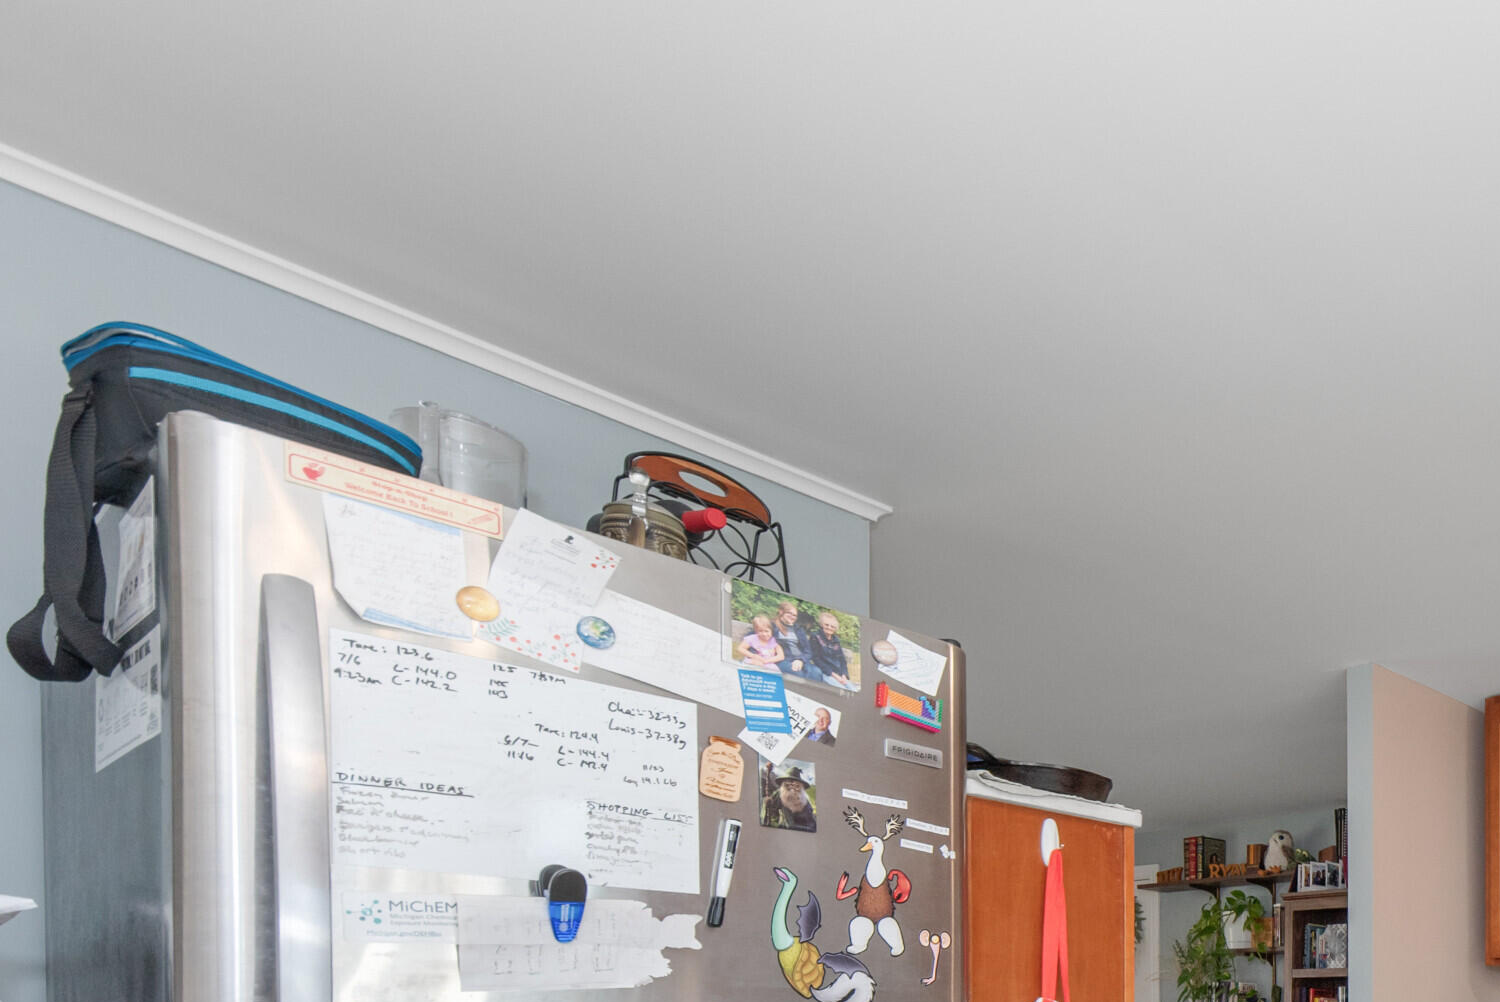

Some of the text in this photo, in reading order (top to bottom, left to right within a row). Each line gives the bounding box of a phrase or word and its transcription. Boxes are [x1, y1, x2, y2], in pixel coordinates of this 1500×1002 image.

[891, 745, 939, 763] FRIGIDAIRE
[335, 771, 465, 796] DINNER IDEAS
[586, 799, 654, 817] SHOPPING
[388, 899, 459, 914] MiChEM
